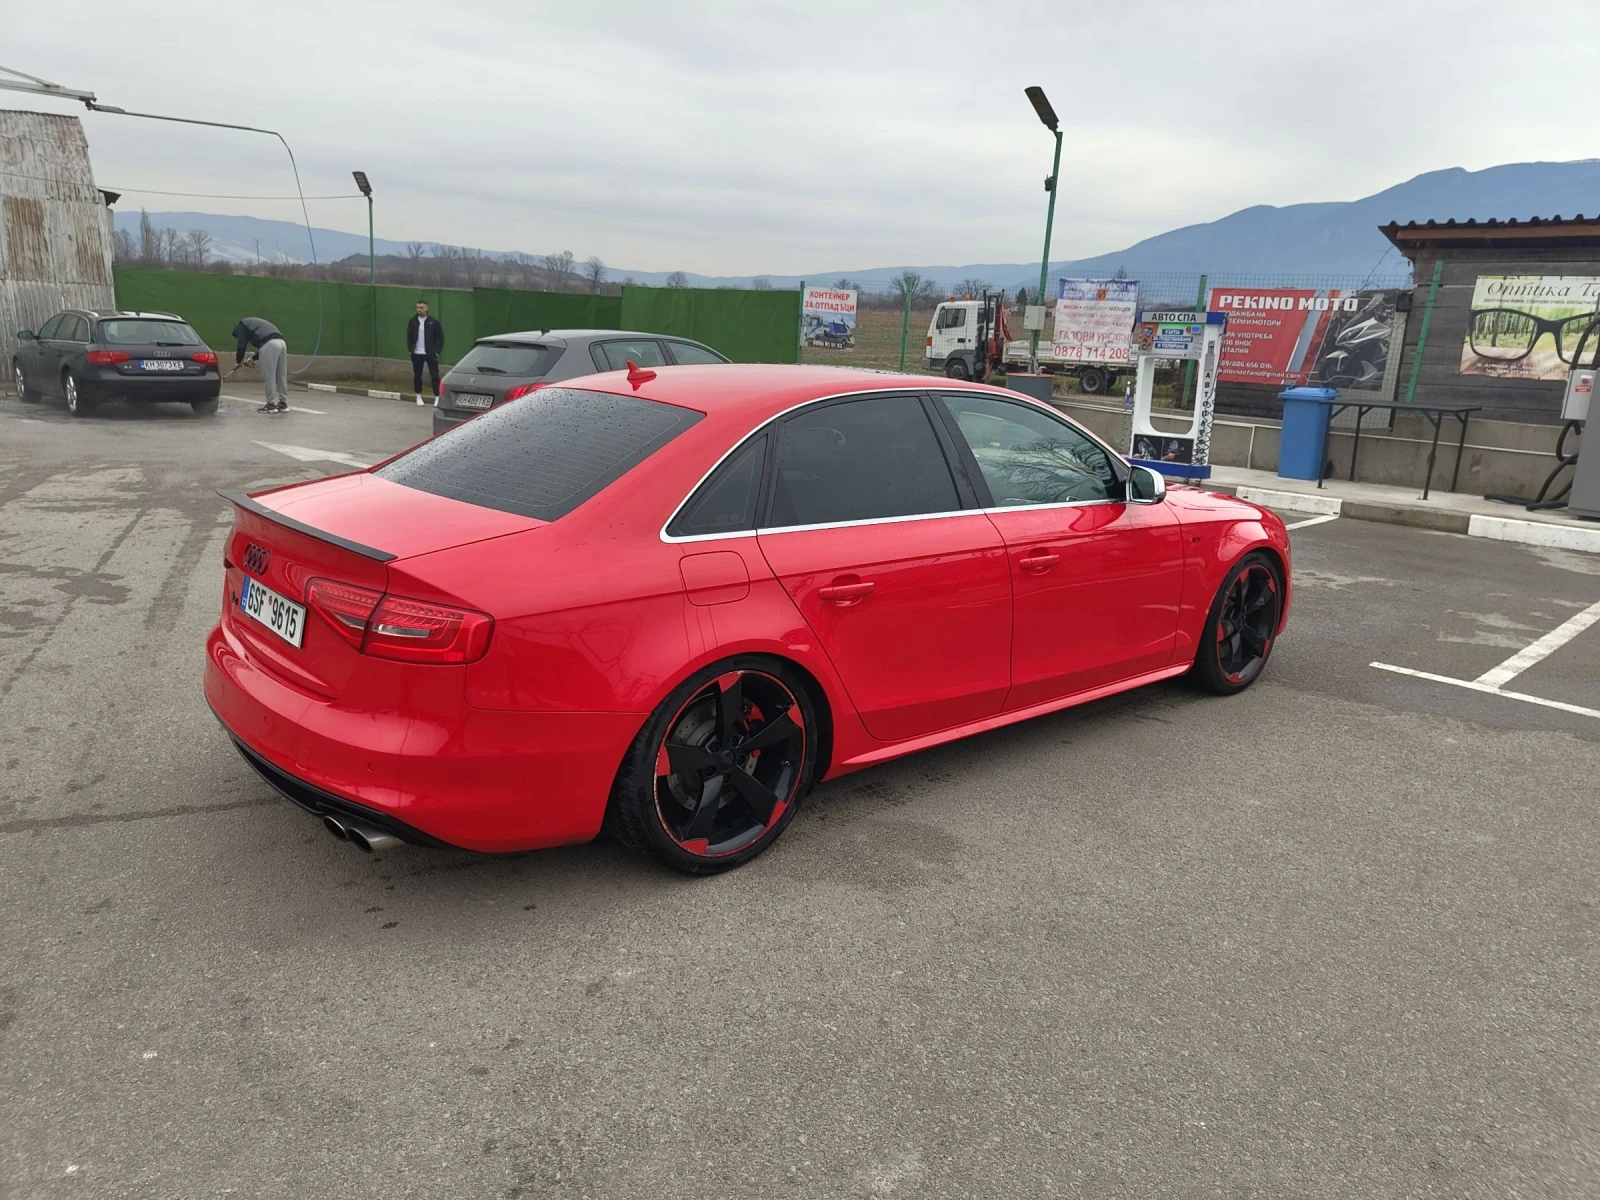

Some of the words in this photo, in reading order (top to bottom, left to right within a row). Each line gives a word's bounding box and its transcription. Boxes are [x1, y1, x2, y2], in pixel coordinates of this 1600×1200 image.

[1487, 281, 1571, 297] Оптика
[810, 291, 850, 301] КОНТЕЙНЕР
[804, 300, 814, 309] ЗА
[815, 302, 855, 312] ОТПАДЪЦИ
[1219, 295, 1294, 309] PEKINO
[1298, 297, 1359, 311] MOTO
[1152, 313, 1176, 321] АВТО
[1177, 314, 1197, 322] СПА
[1059, 330, 1094, 342] ГАЗОВИ
[1054, 345, 1082, 357] 0878
[1087, 347, 1106, 358] 714
[1109, 348, 1129, 359] 208
[247, 582, 267, 617] 6SF
[271, 597, 299, 639] 9615
